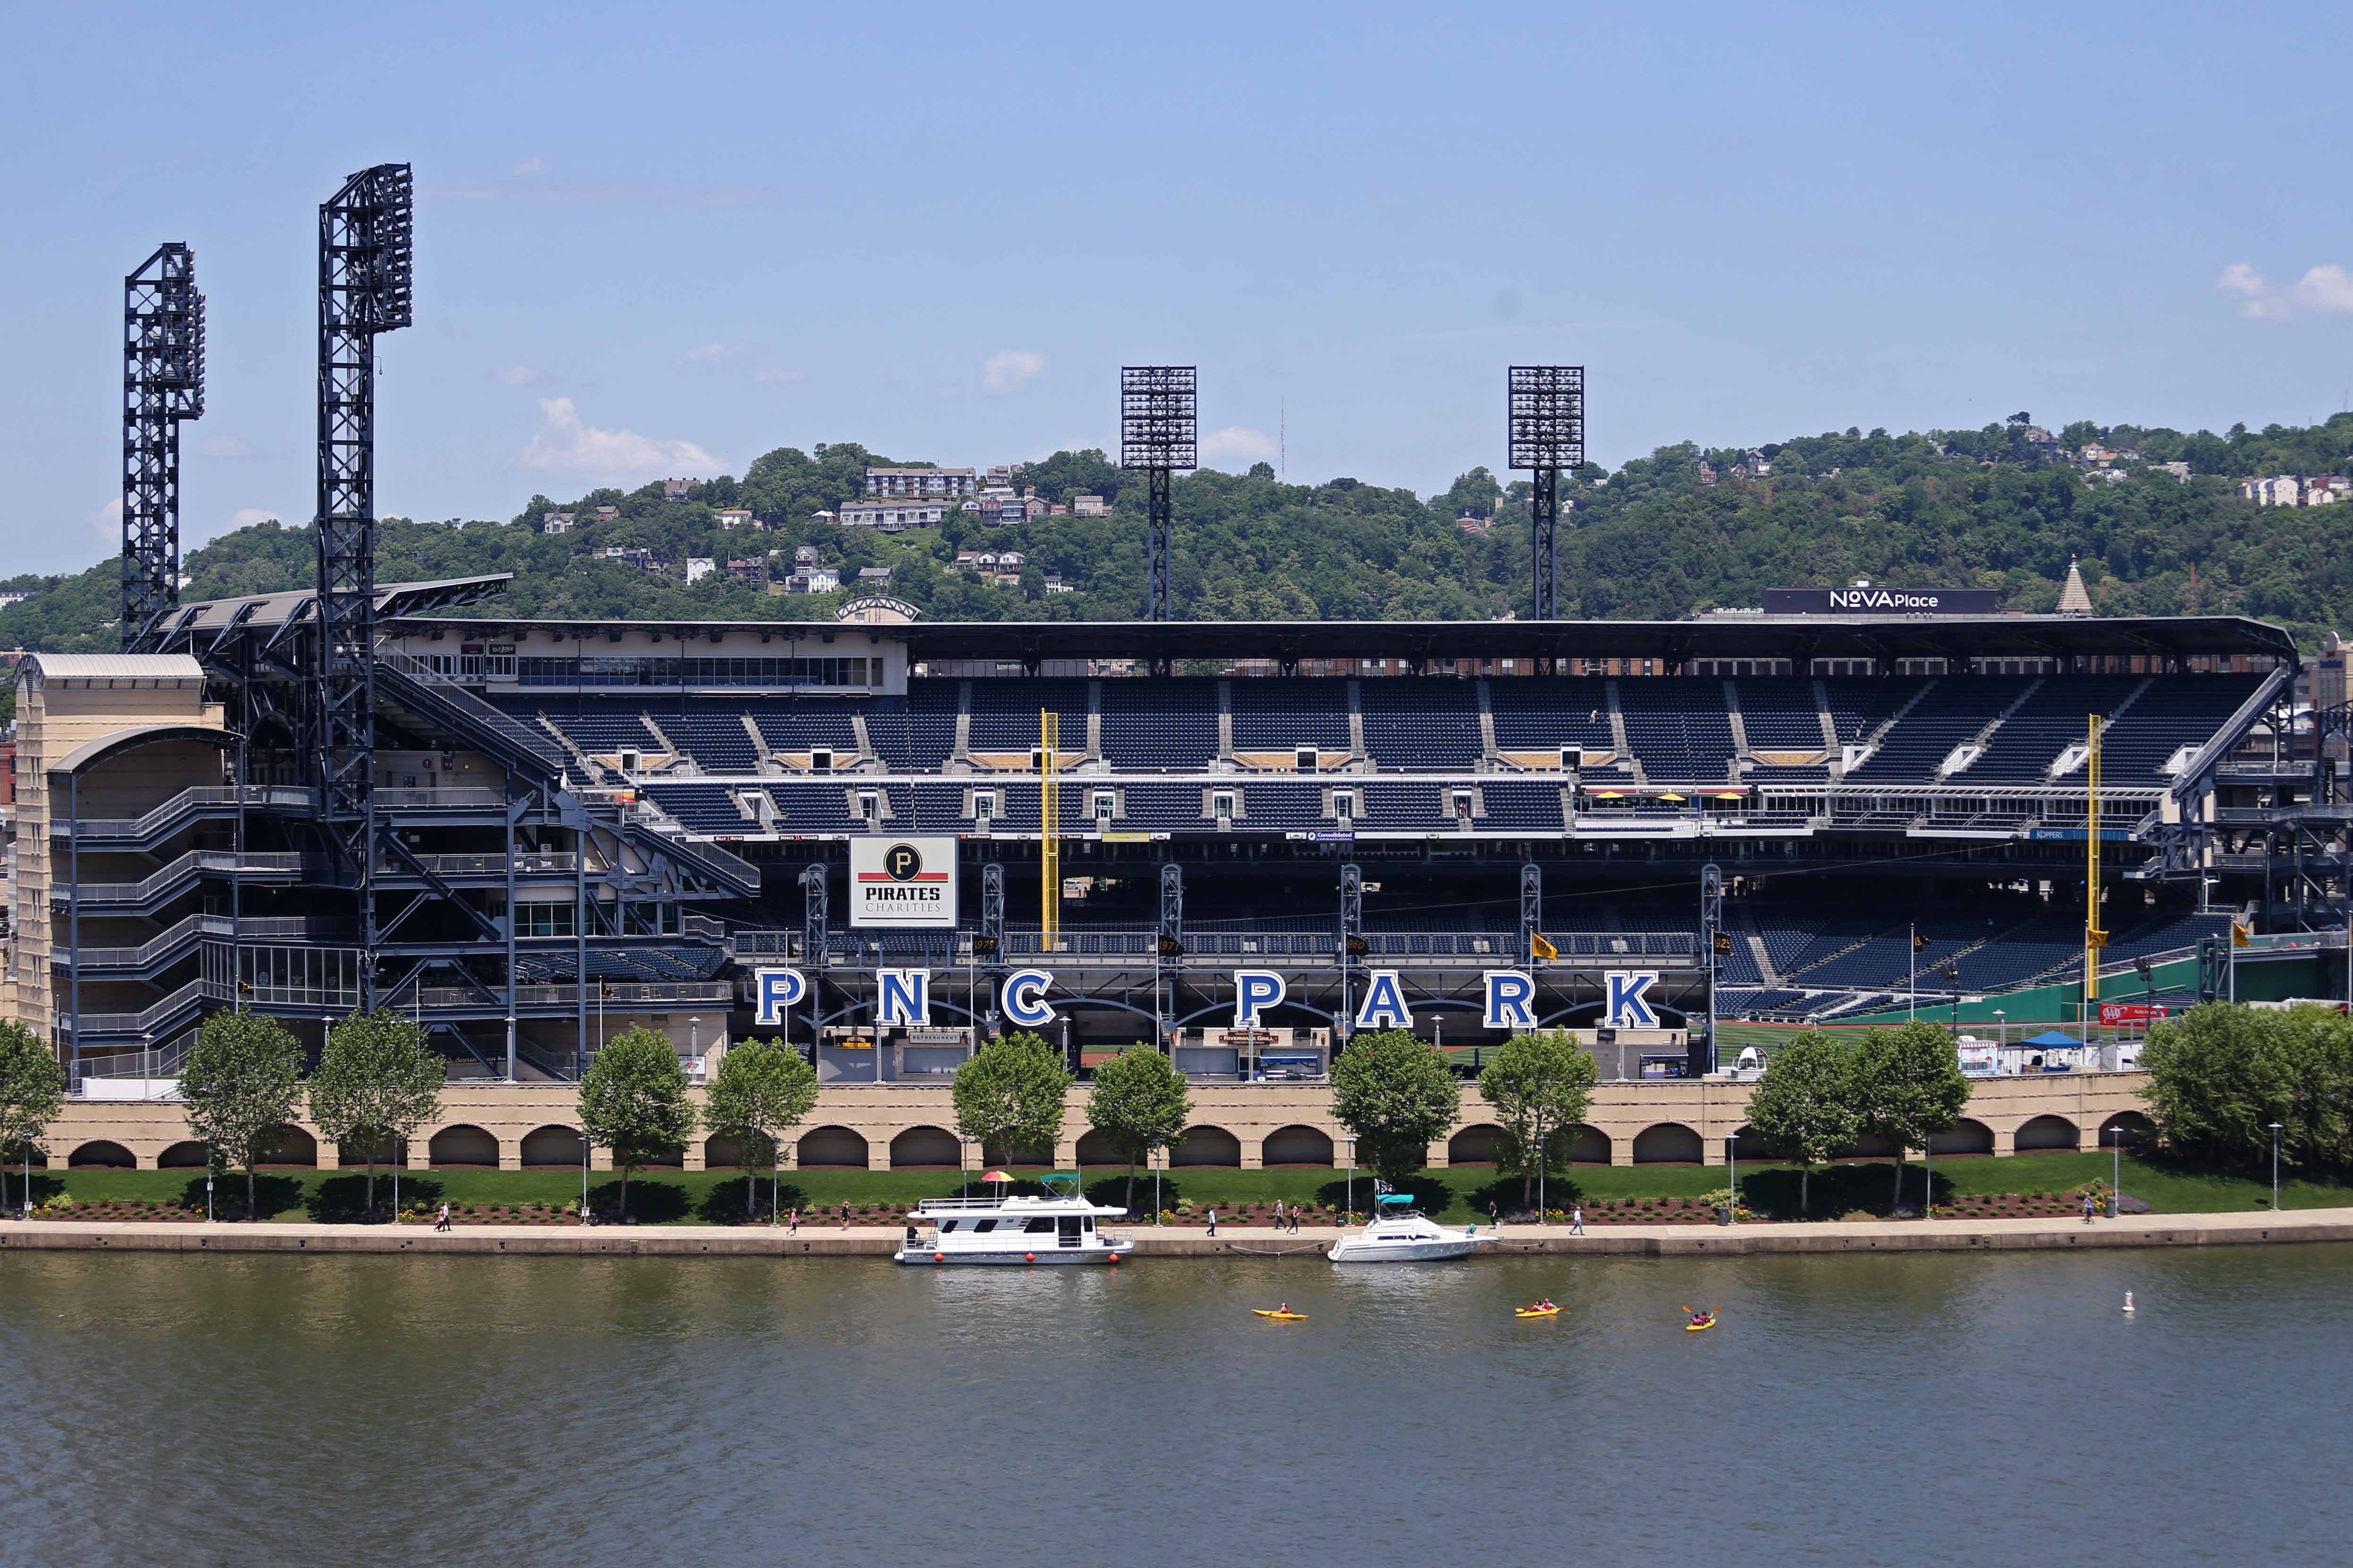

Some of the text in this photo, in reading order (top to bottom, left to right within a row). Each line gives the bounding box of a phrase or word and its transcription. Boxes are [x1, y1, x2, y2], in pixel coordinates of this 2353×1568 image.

[1895, 594, 1938, 607] Place
[2036, 830, 2063, 839] KOPPERS
[896, 852, 912, 874] P
[866, 887, 940, 901] PIRATES
[866, 902, 940, 912] CHARITIES
[755, 968, 1660, 1028] PNC PARK
